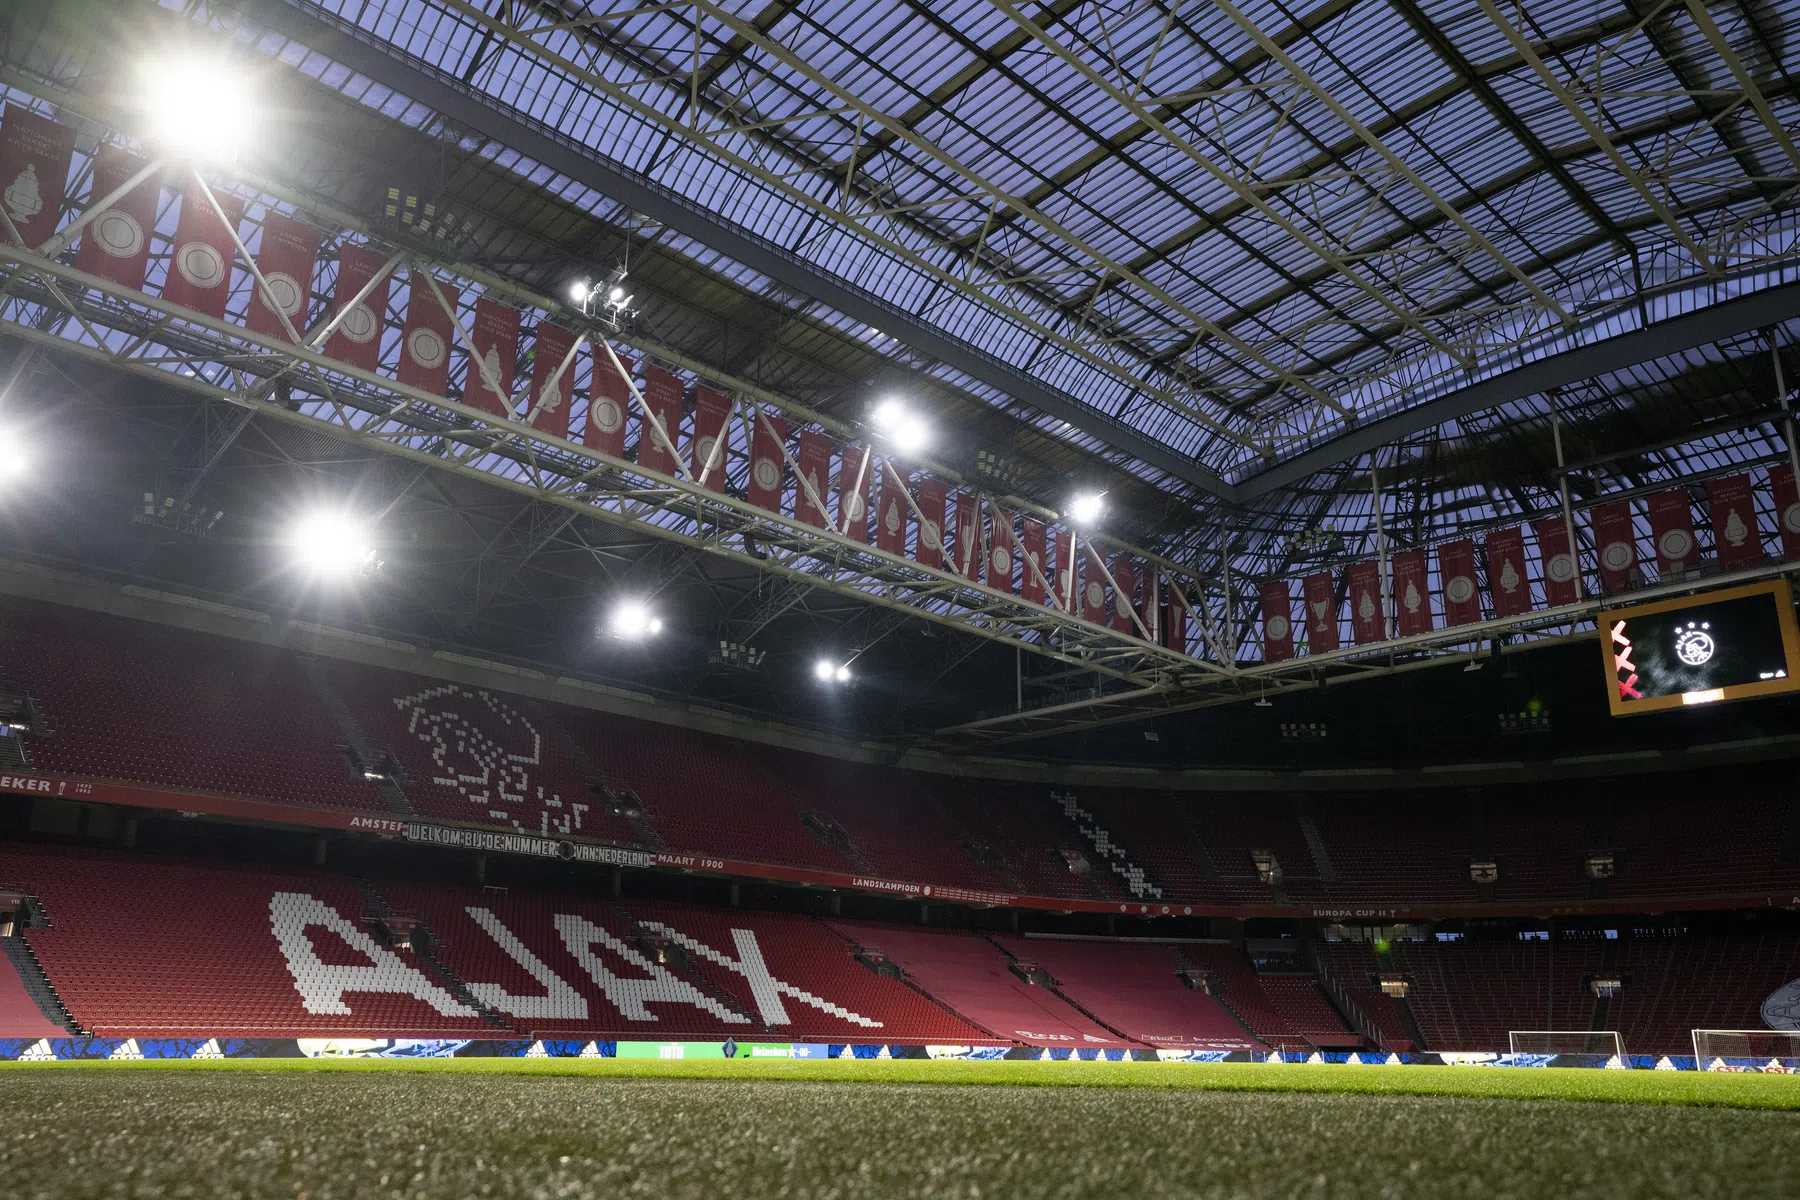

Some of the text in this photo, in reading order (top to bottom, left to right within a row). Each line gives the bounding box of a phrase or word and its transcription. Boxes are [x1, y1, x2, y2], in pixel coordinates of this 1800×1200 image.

[409, 824, 460, 845] WELKOM
[463, 832, 482, 848] BIJ
[486, 833, 502, 849] DE
[504, 836, 557, 855] NUMMER
[576, 845, 596, 860] VAN
[598, 847, 650, 866] NEDERLAND
[658, 854, 724, 869] MAART 1900
[852, 878, 920, 893] LANDSKAMPIOEN
[1313, 909, 1353, 917] EUROPA
[1355, 909, 1375, 917] CUP
[268, 891, 884, 1028] AJAX
[752, 1046, 788, 1057] Heineken
